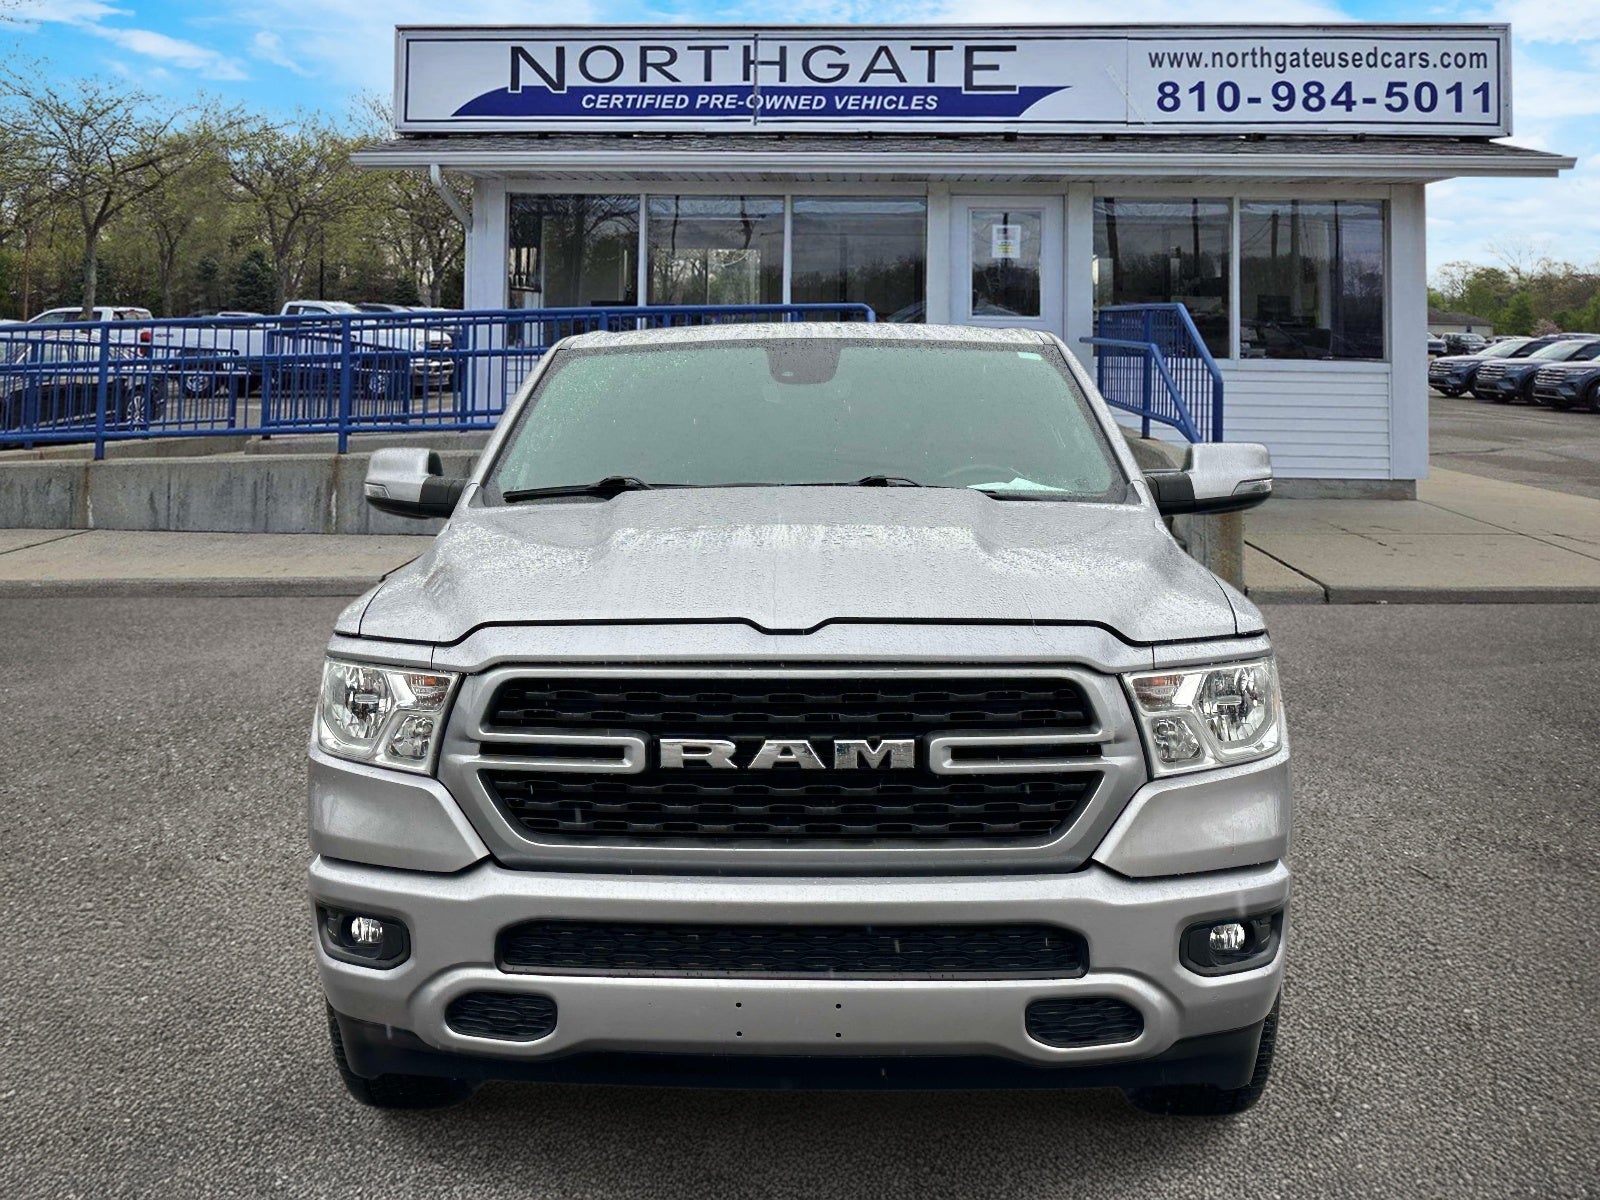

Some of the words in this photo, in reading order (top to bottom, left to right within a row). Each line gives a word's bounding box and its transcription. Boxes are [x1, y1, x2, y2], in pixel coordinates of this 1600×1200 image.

[509, 44, 1018, 92] NORTHGATE
[1148, 46, 1488, 74] www.northgateusedcars.com
[581, 94, 690, 110] CERTIFIED
[695, 94, 828, 111] PRE-OWNED
[834, 95, 939, 111] VEHICLES
[1156, 80, 1491, 114] 810-984-5011
[659, 738, 915, 769] RAM
